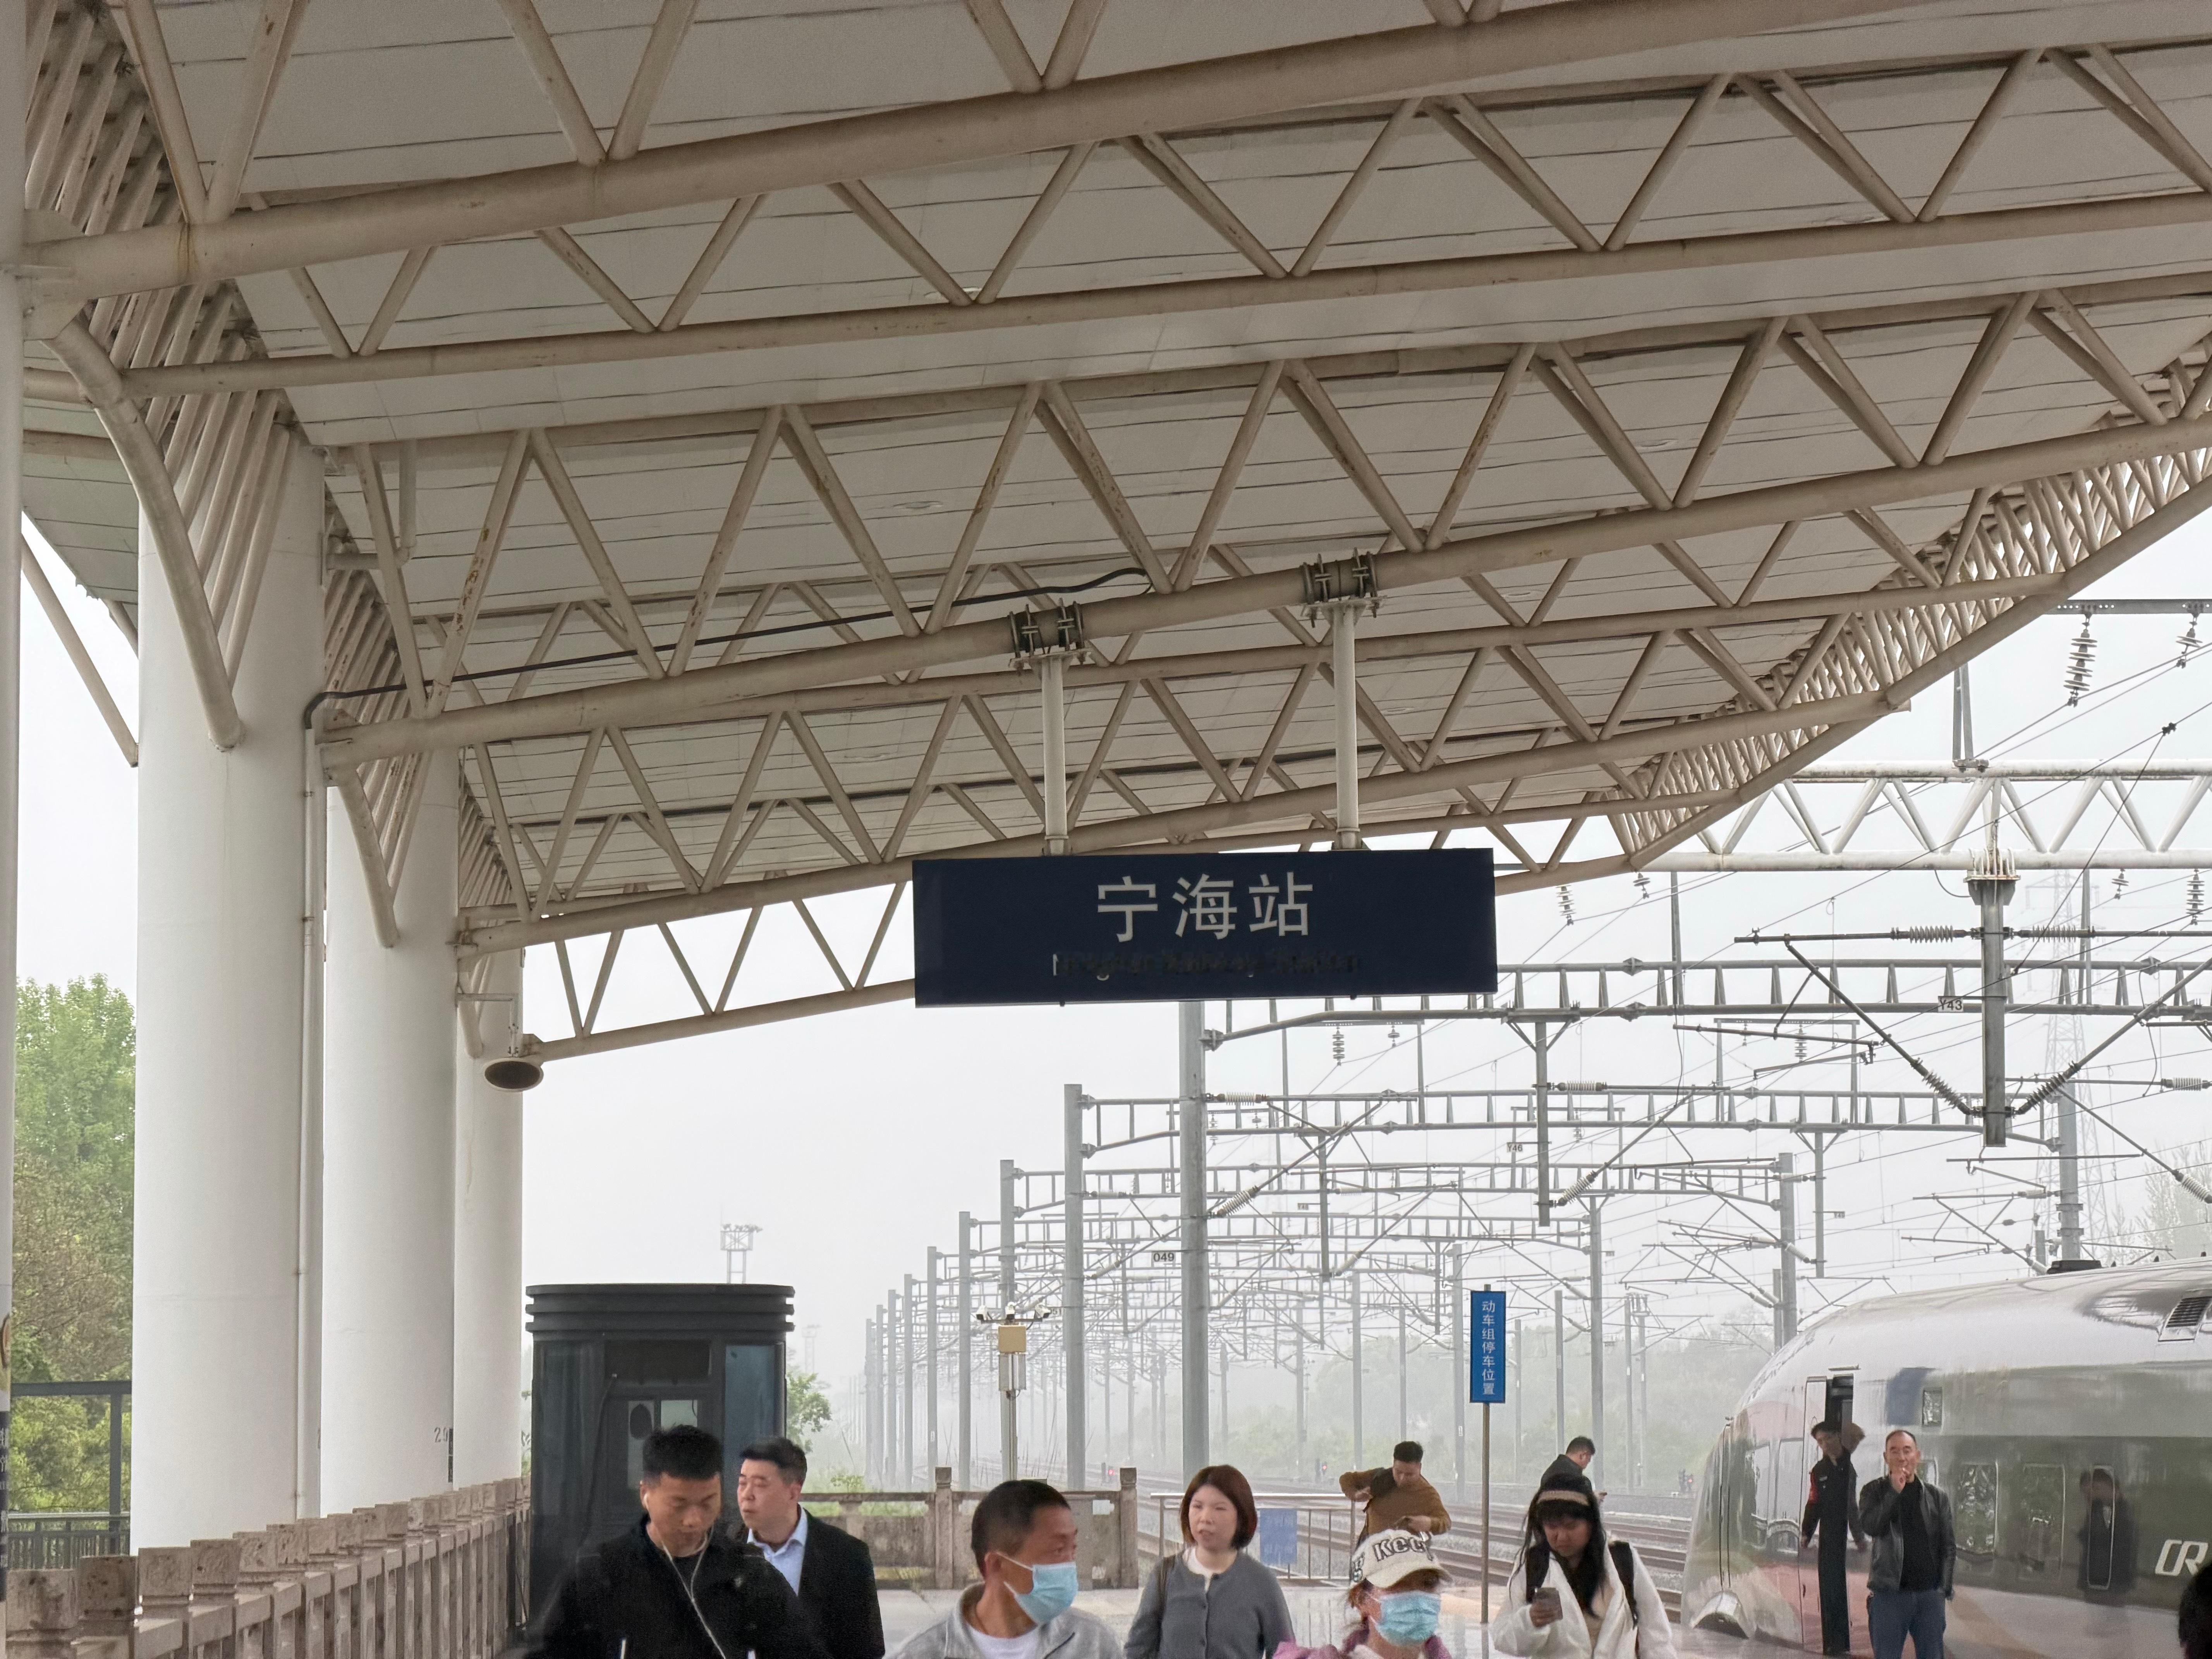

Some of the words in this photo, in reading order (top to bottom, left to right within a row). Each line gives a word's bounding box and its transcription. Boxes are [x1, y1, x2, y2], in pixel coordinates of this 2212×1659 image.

[1097, 871, 1313, 943] 宁海站
[1939, 998, 1962, 1010] Y43
[1153, 1253, 1174, 1262] 049
[1482, 1300, 1495, 1395] 动车组停车位置
[2155, 1539, 2209, 1576] CR
